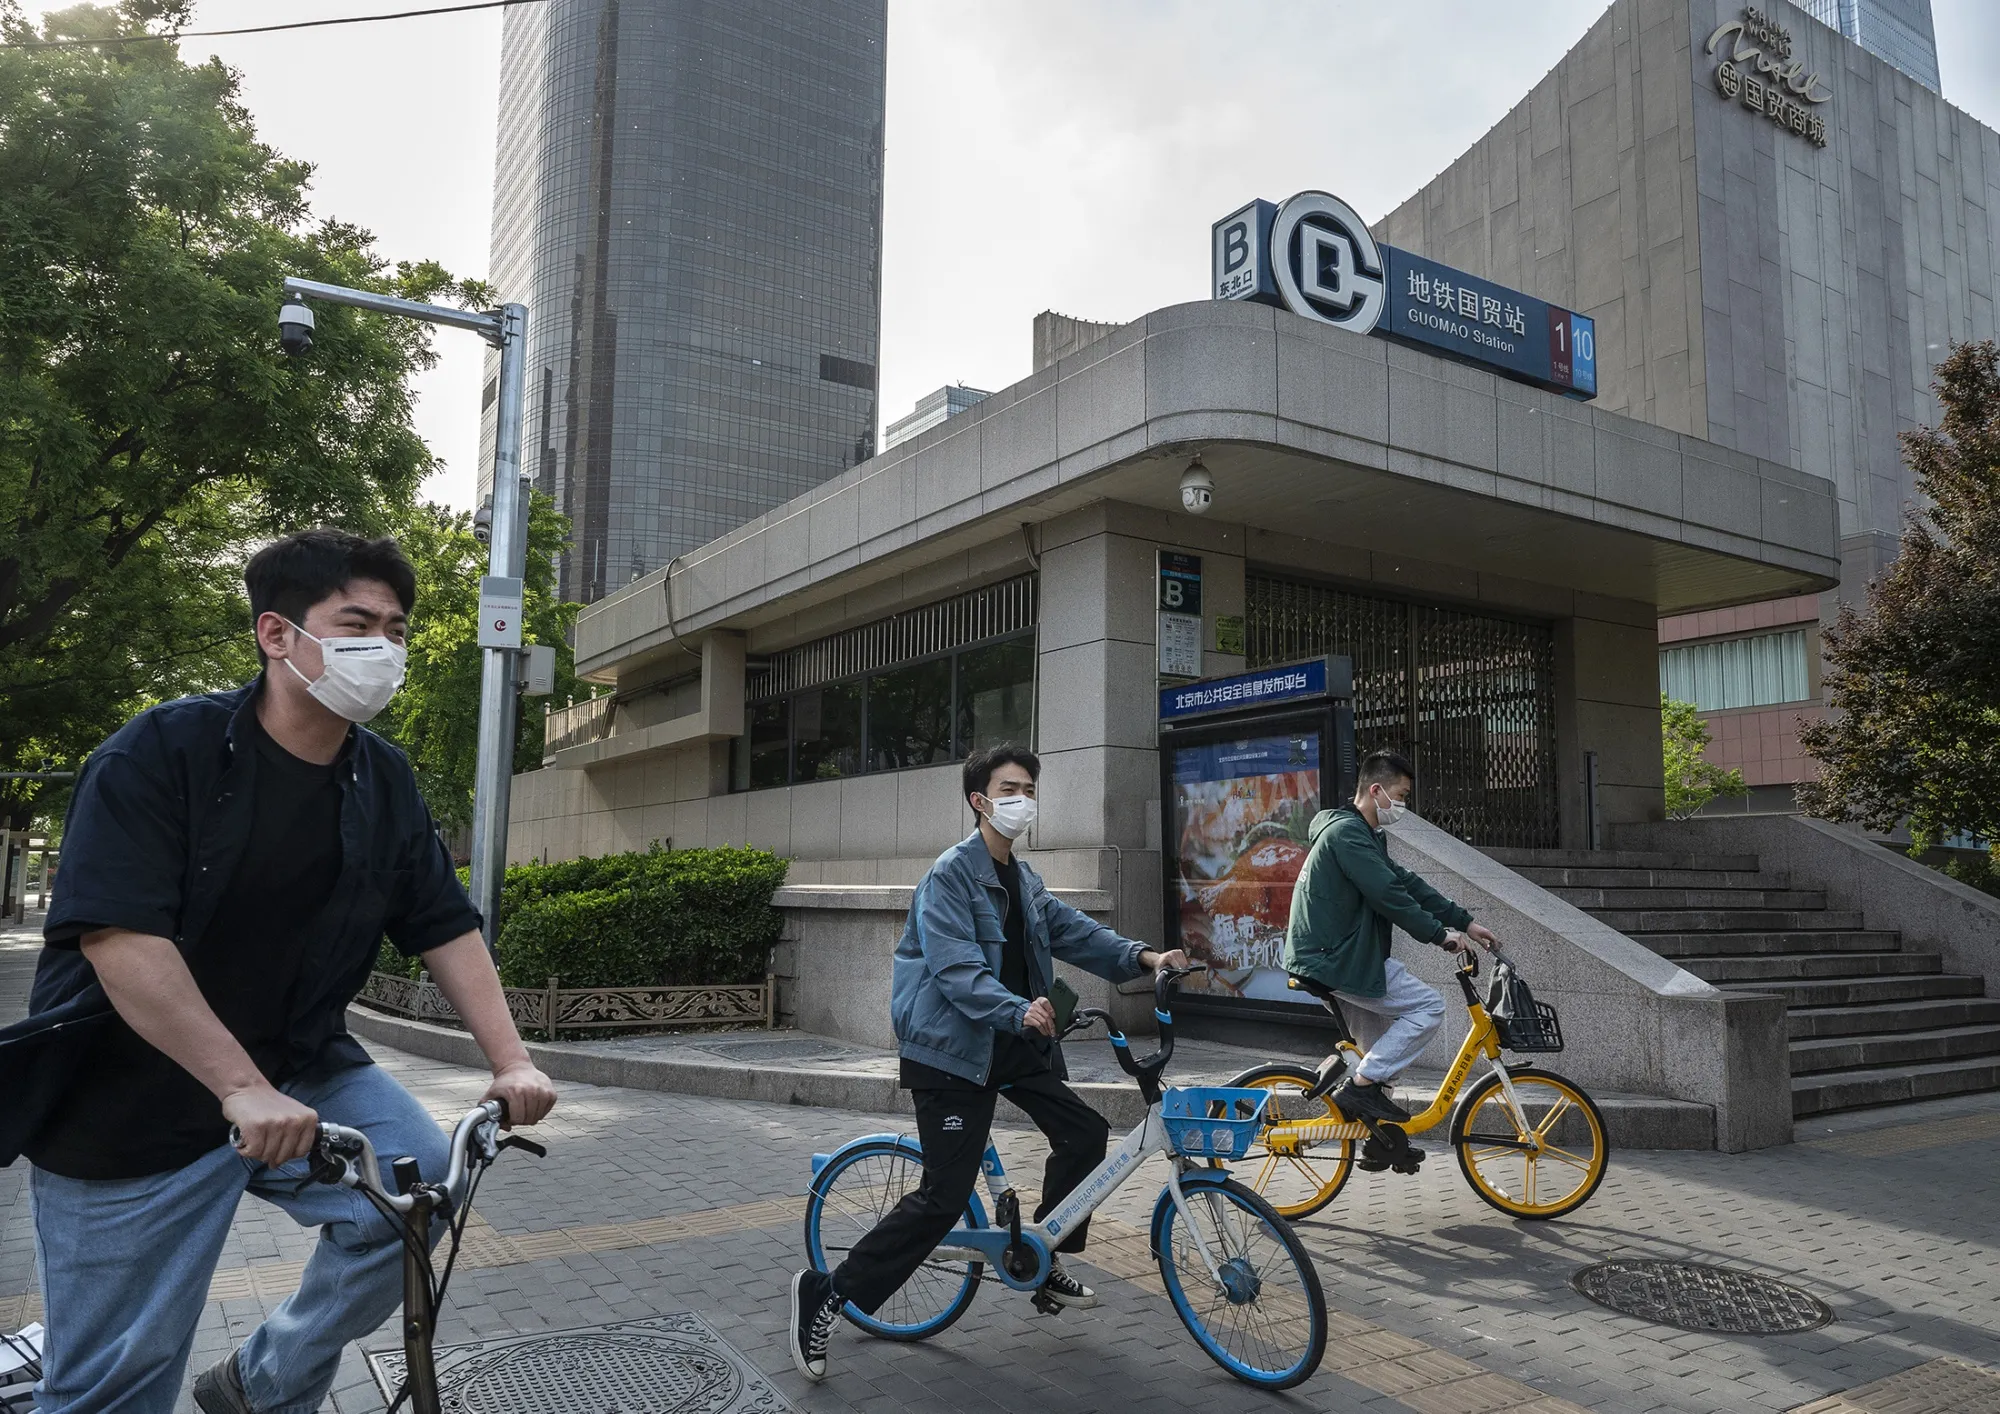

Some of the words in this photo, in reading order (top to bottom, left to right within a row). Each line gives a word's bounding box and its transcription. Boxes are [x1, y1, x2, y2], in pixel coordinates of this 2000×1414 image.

[1745, 75, 1827, 147] 国贸商城
[1224, 221, 1249, 275] B
[1219, 269, 1252, 297] 东北口
[1407, 269, 1525, 336] 地铁国贸站
[1408, 308, 1468, 338] GUOMAO
[1473, 329, 1514, 353] Station
[1555, 321, 1565, 352] 1
[1573, 327, 1593, 361] 10
[1166, 579, 1184, 607] B
[1175, 673, 1307, 709] 北京市公共安全信息发布平台
